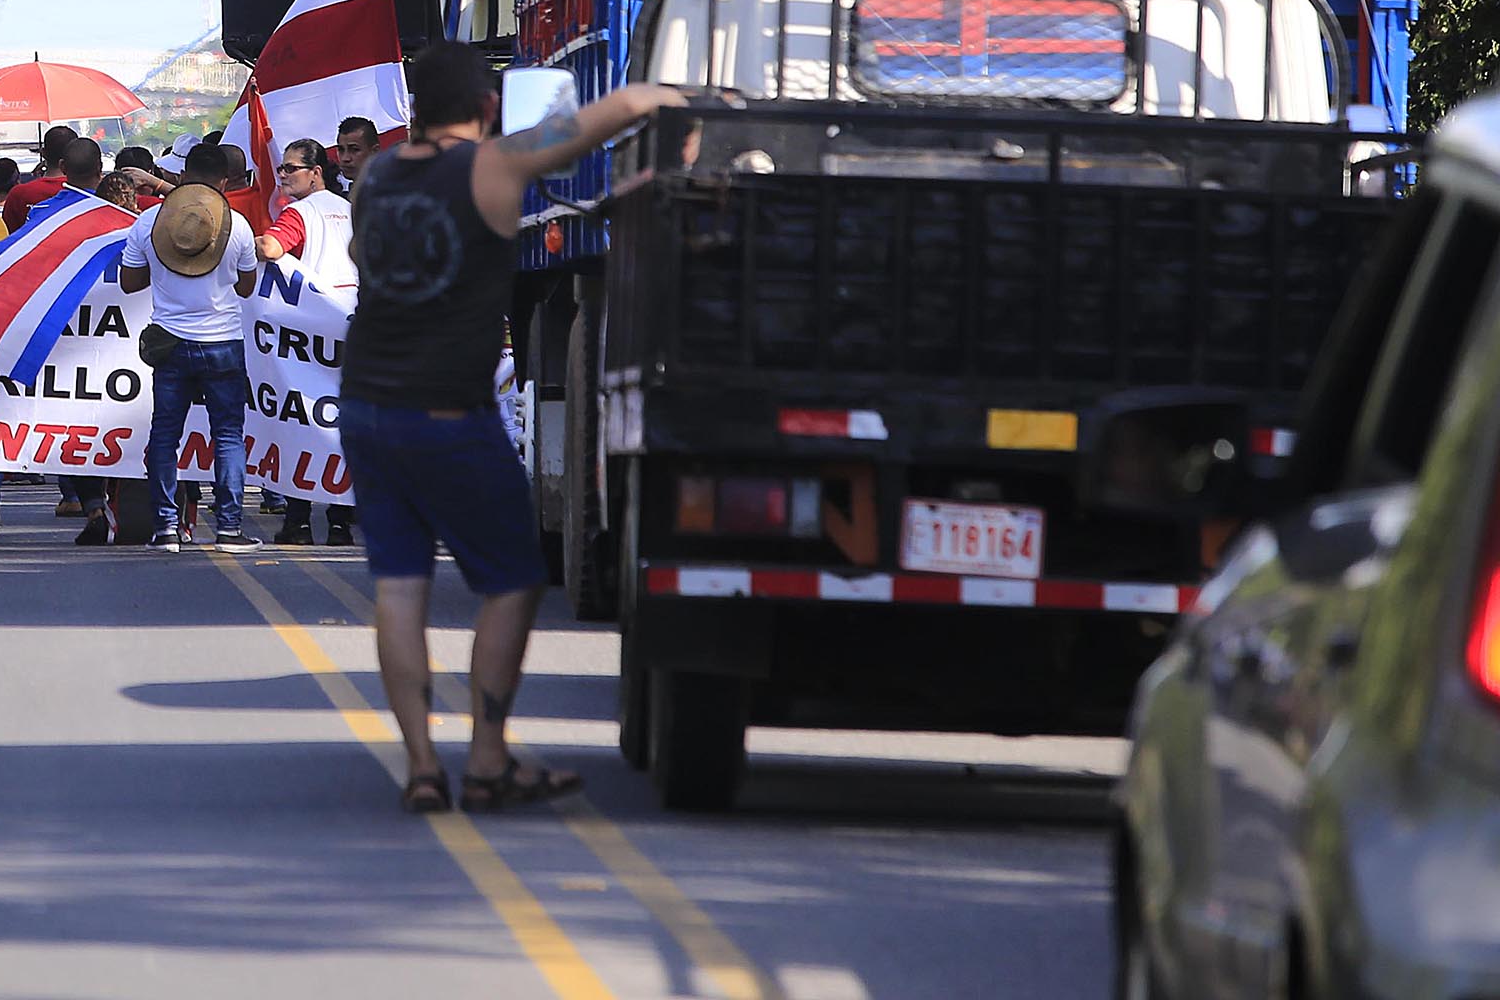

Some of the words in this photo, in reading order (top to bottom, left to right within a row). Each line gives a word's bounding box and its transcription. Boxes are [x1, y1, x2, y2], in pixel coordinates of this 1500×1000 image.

[254, 319, 343, 369] CRU
[292, 450, 351, 495] LU
[931, 520, 1034, 560] 118164
